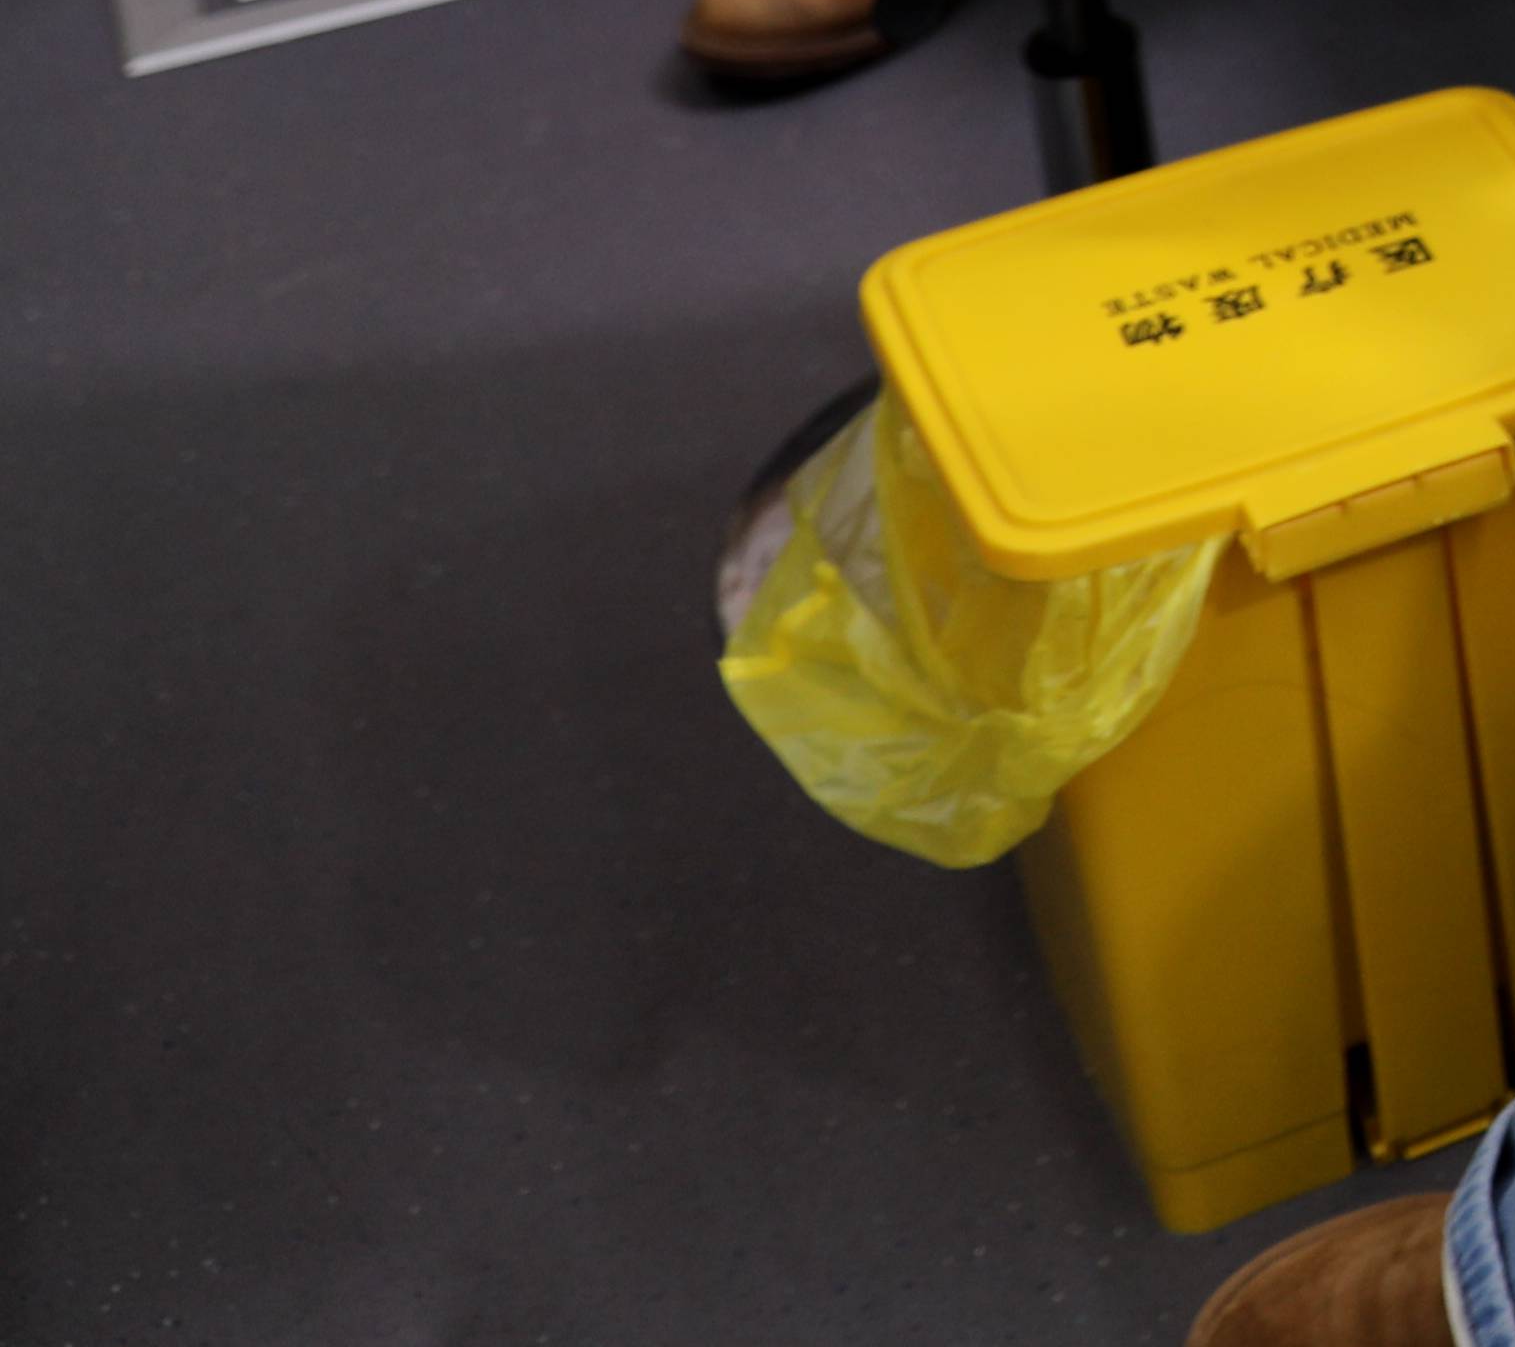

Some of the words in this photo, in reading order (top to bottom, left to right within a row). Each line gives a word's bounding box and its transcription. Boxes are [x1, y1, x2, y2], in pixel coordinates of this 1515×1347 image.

[1247, 210, 1419, 269] MEDICAL
[1101, 266, 1236, 317] WASTE
[1118, 235, 1435, 348] 医疗废物
